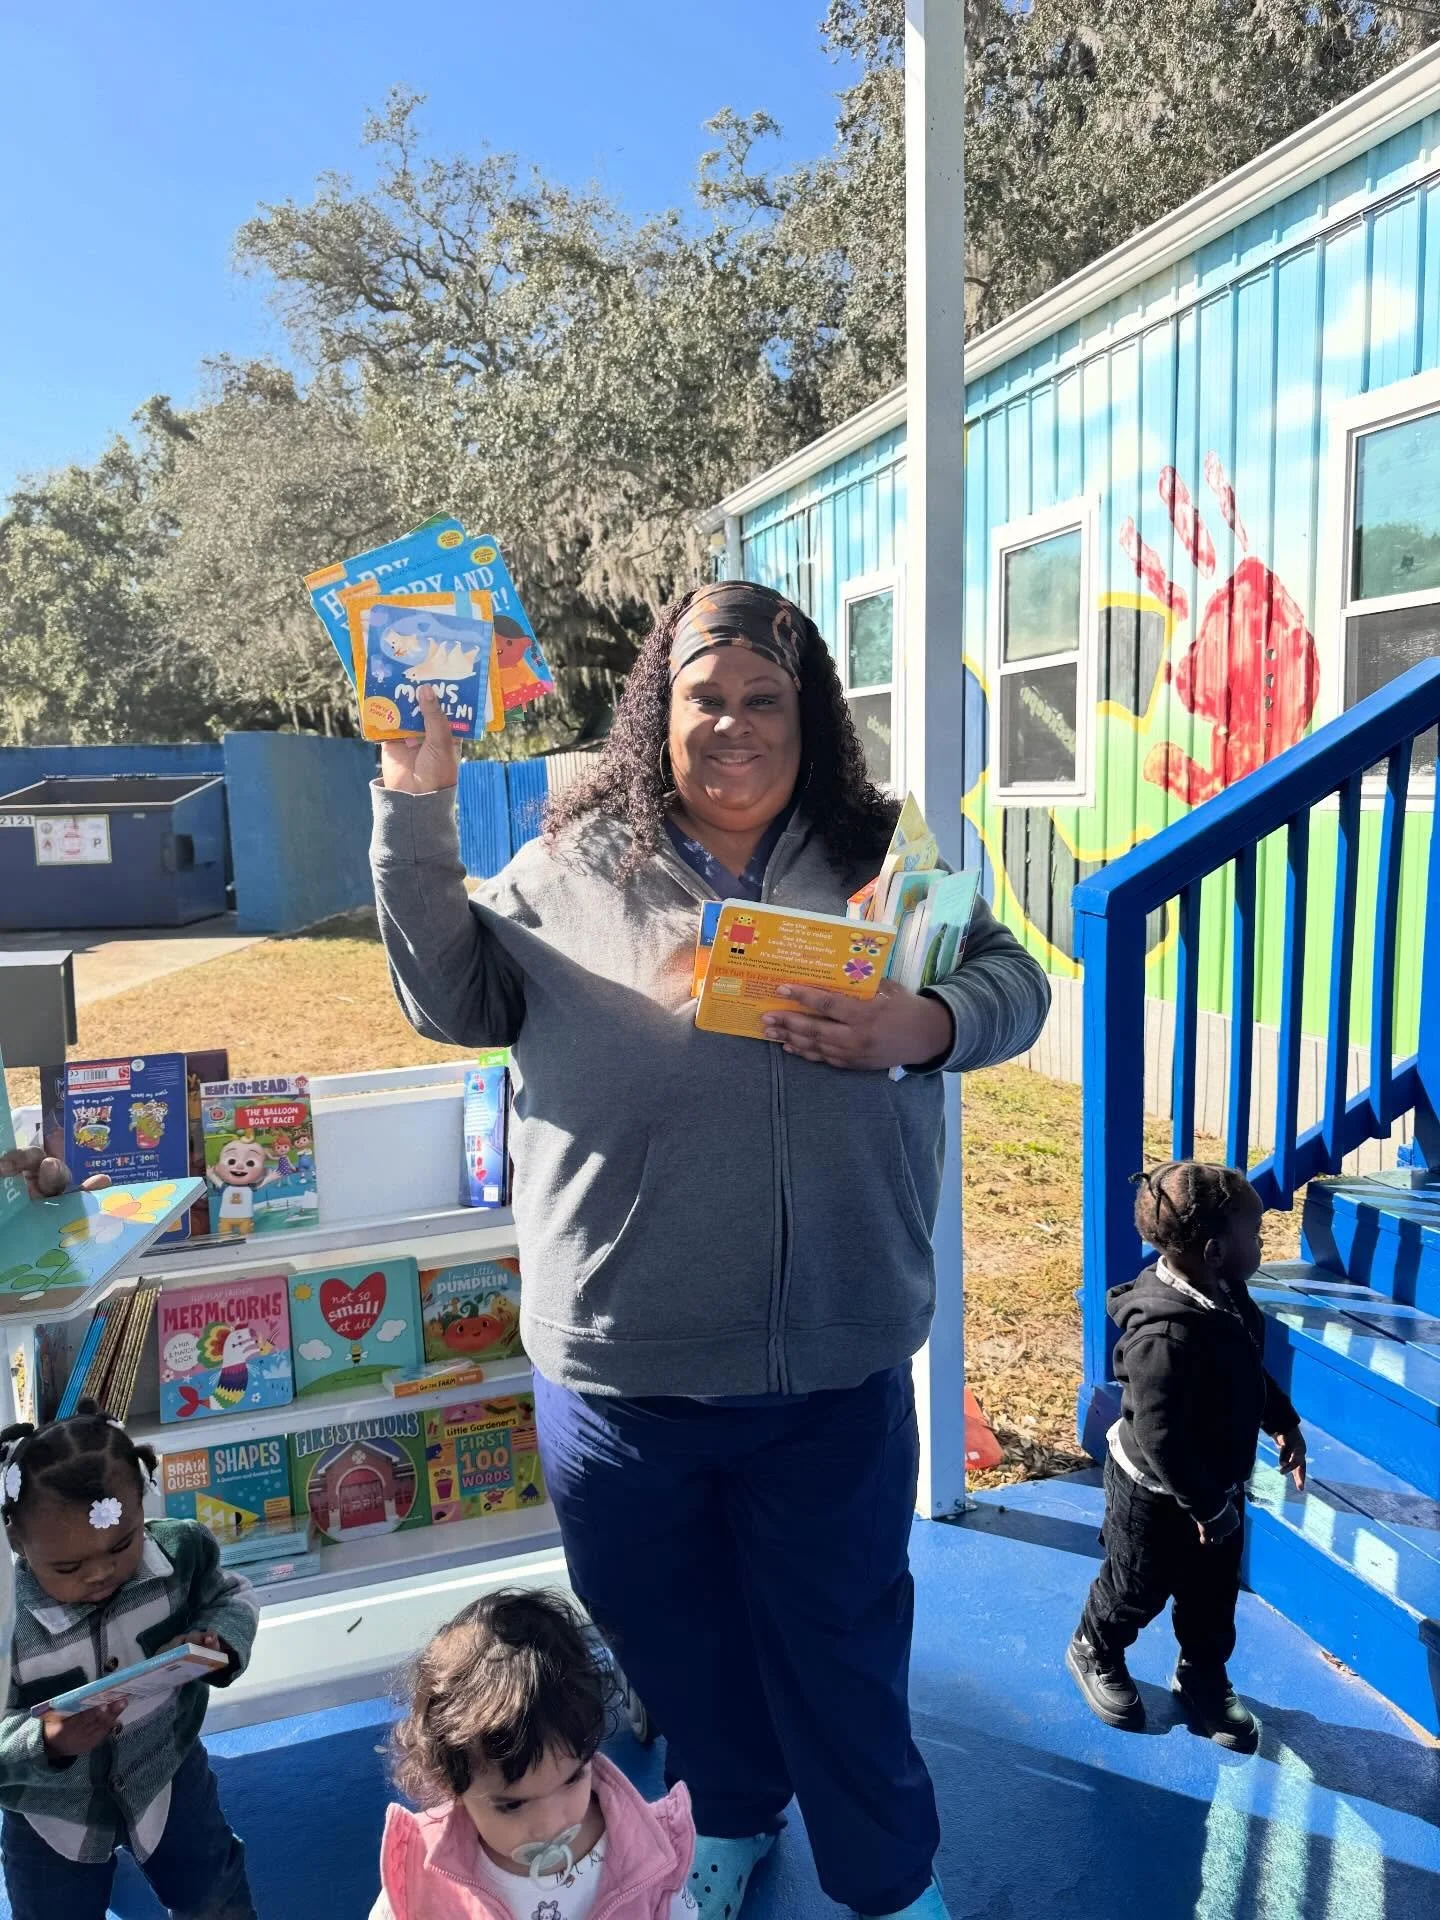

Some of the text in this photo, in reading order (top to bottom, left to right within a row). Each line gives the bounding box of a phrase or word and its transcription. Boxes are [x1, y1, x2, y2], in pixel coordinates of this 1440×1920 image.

[454, 566, 494, 591] AND
[491, 586, 510, 612] T!
[456, 704, 472, 720] IN
[264, 1107, 298, 1115] BALLOON
[272, 1116, 295, 1124] RACE!
[437, 1274, 508, 1294] PUMPKIN
[331, 1291, 371, 1304] not so
[328, 1300, 379, 1322] small
[336, 1318, 371, 1332] at all
[296, 1412, 419, 1458] FIRE STATIONS
[447, 1418, 516, 1436] Little Gardener's
[460, 1432, 506, 1450] FIRST
[215, 1440, 280, 1474] SHAPES
[461, 1446, 508, 1474] 100
[168, 1458, 206, 1477] BRAIN
[168, 1472, 207, 1490] QUEST
[462, 1469, 510, 1488] WORDS
